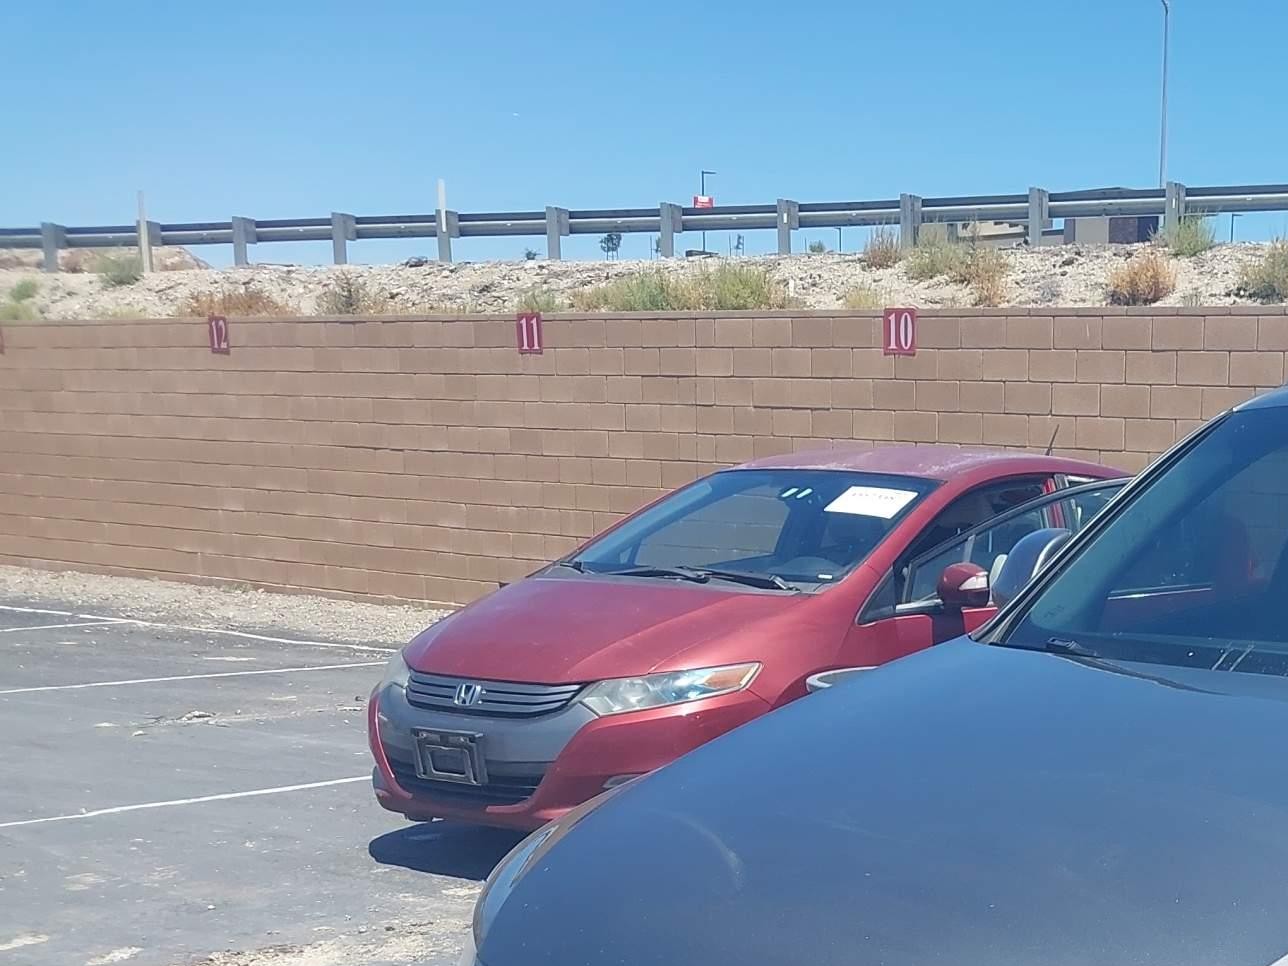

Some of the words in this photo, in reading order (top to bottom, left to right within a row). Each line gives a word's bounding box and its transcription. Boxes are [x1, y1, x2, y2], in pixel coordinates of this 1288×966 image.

[211, 319, 228, 349] 12
[519, 316, 540, 350] 11
[887, 312, 912, 350] 10
